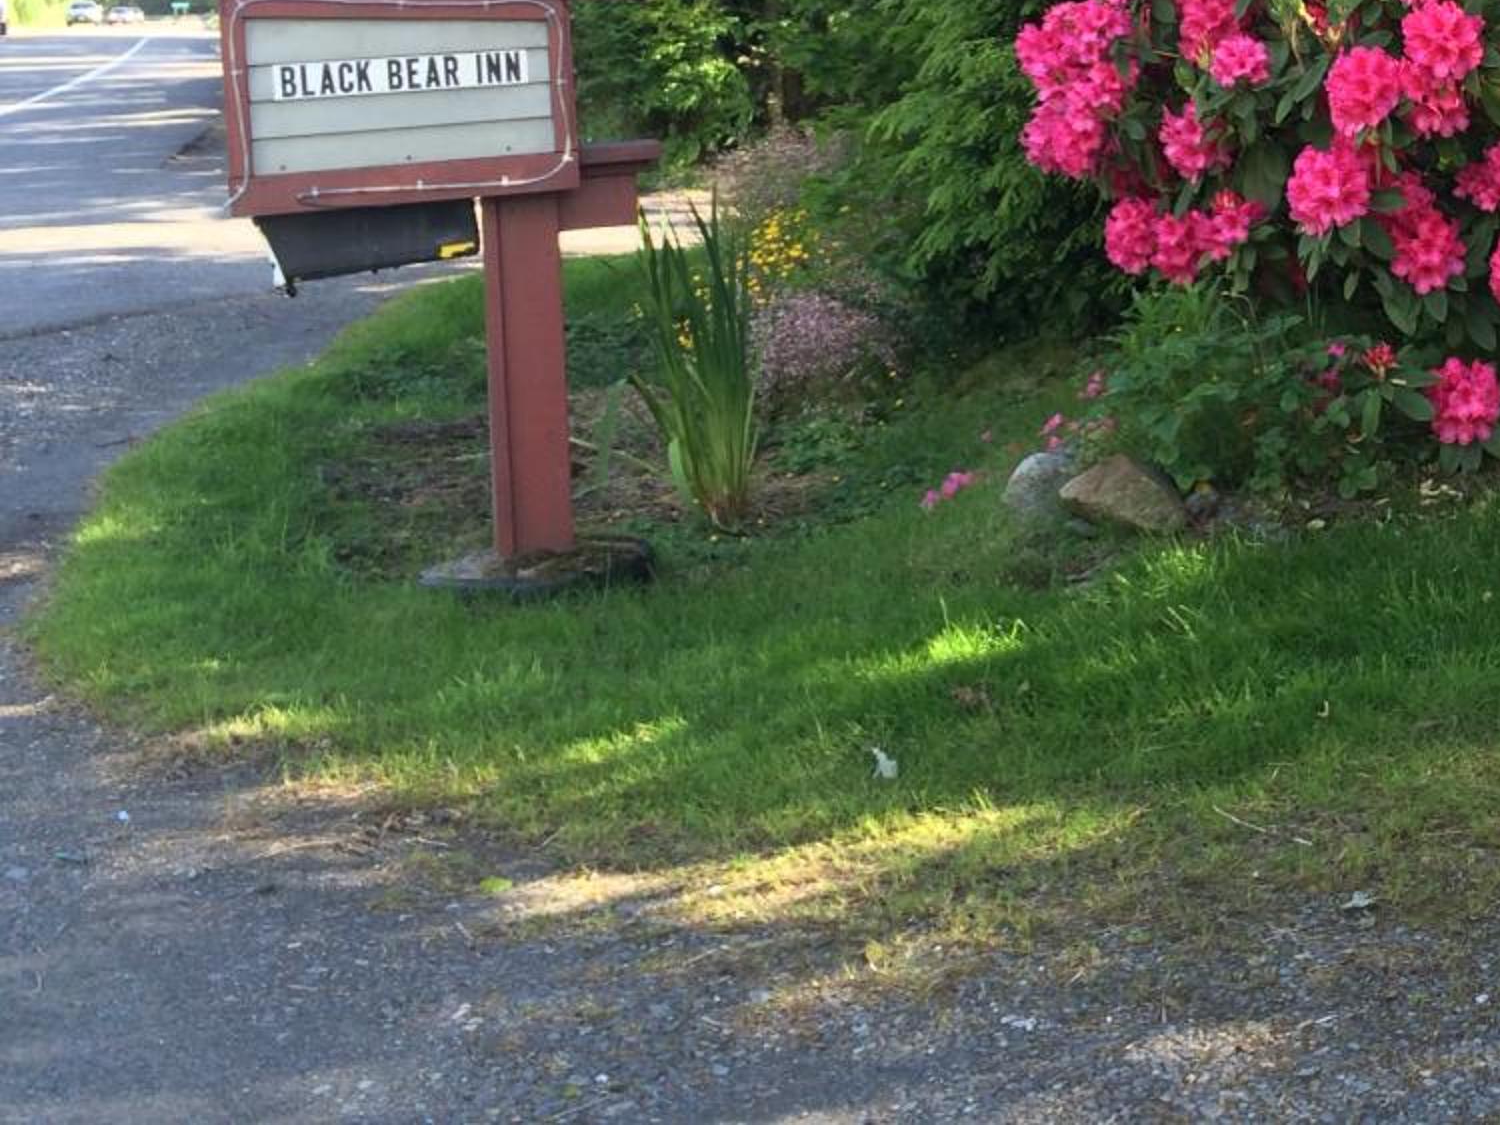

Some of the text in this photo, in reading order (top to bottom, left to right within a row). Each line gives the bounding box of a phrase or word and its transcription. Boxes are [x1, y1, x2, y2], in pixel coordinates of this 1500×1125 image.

[280, 52, 521, 97] BLACK BEAR INN
